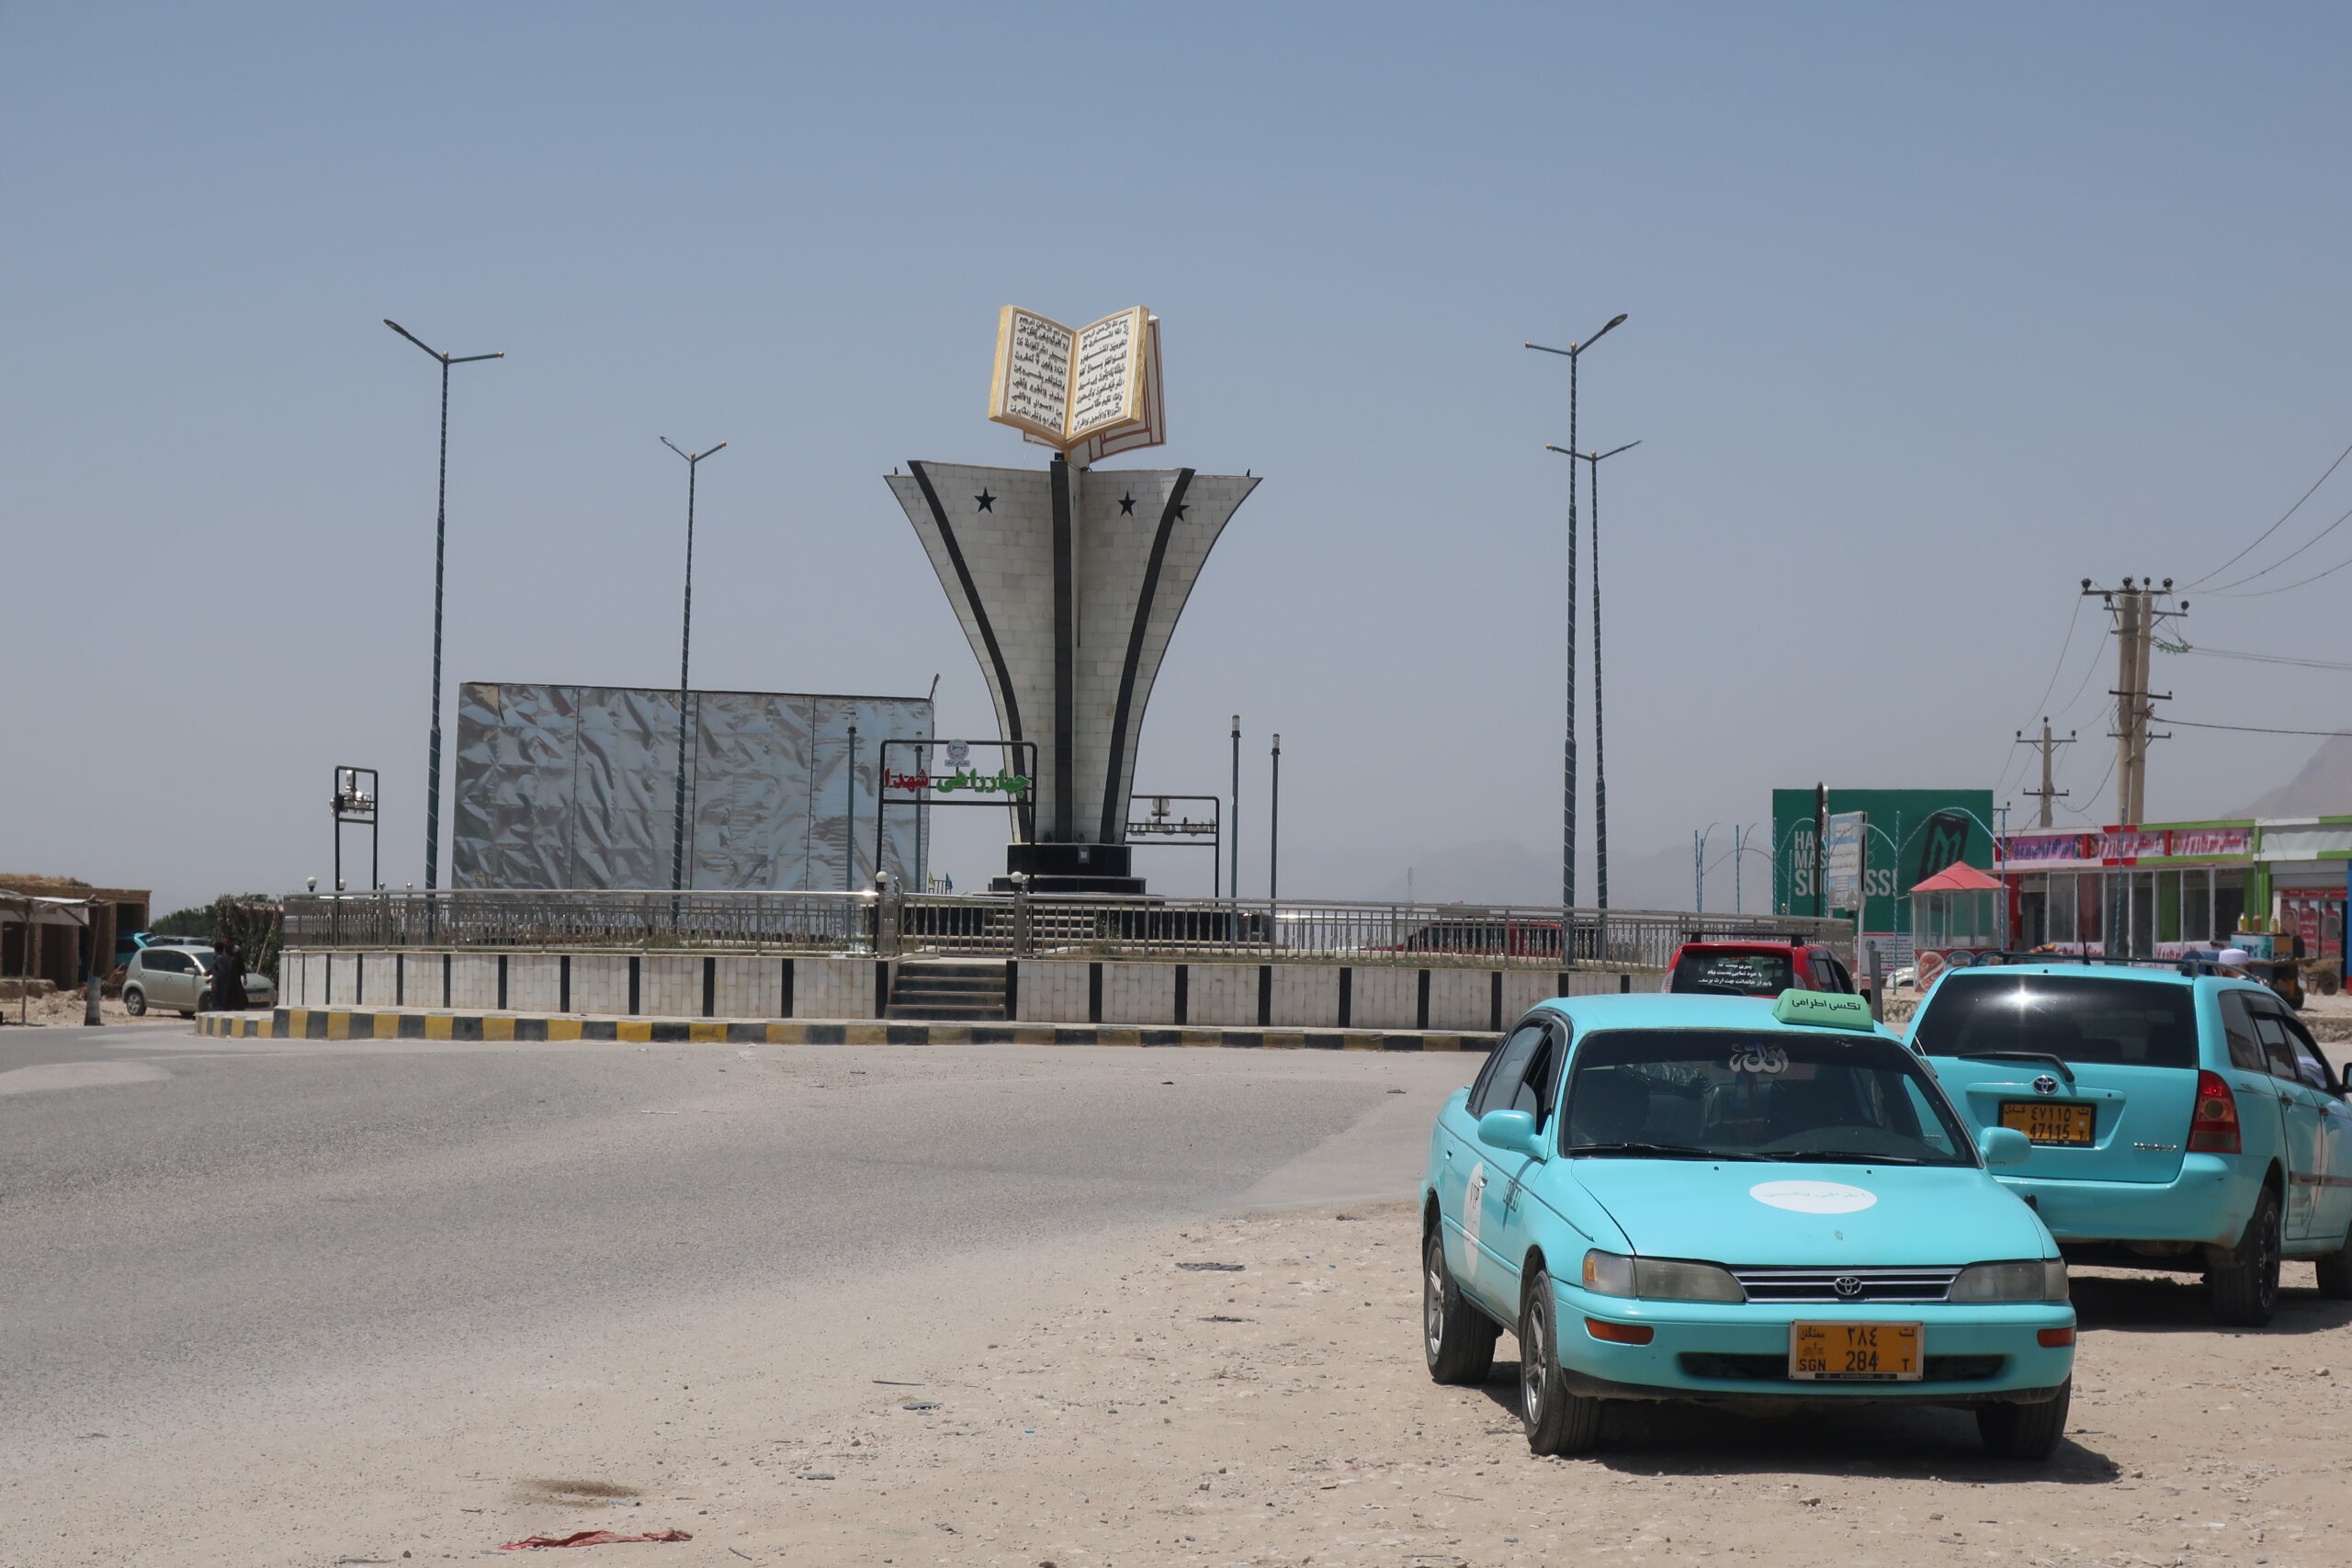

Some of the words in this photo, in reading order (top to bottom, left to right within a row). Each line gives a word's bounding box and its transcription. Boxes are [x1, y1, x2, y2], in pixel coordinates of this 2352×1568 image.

[884, 768, 930, 793] شهدا
[1794, 830, 1817, 850] HA
[1792, 998, 1828, 1010] اطرافی
[1829, 1001, 1861, 1012] تکسی
[2030, 1122, 2070, 1139] 47115
[2078, 1130, 2086, 1141] T
[1799, 1359, 1826, 1371] SGN
[1845, 1350, 1879, 1371] 284
[1902, 1359, 1910, 1371] T
